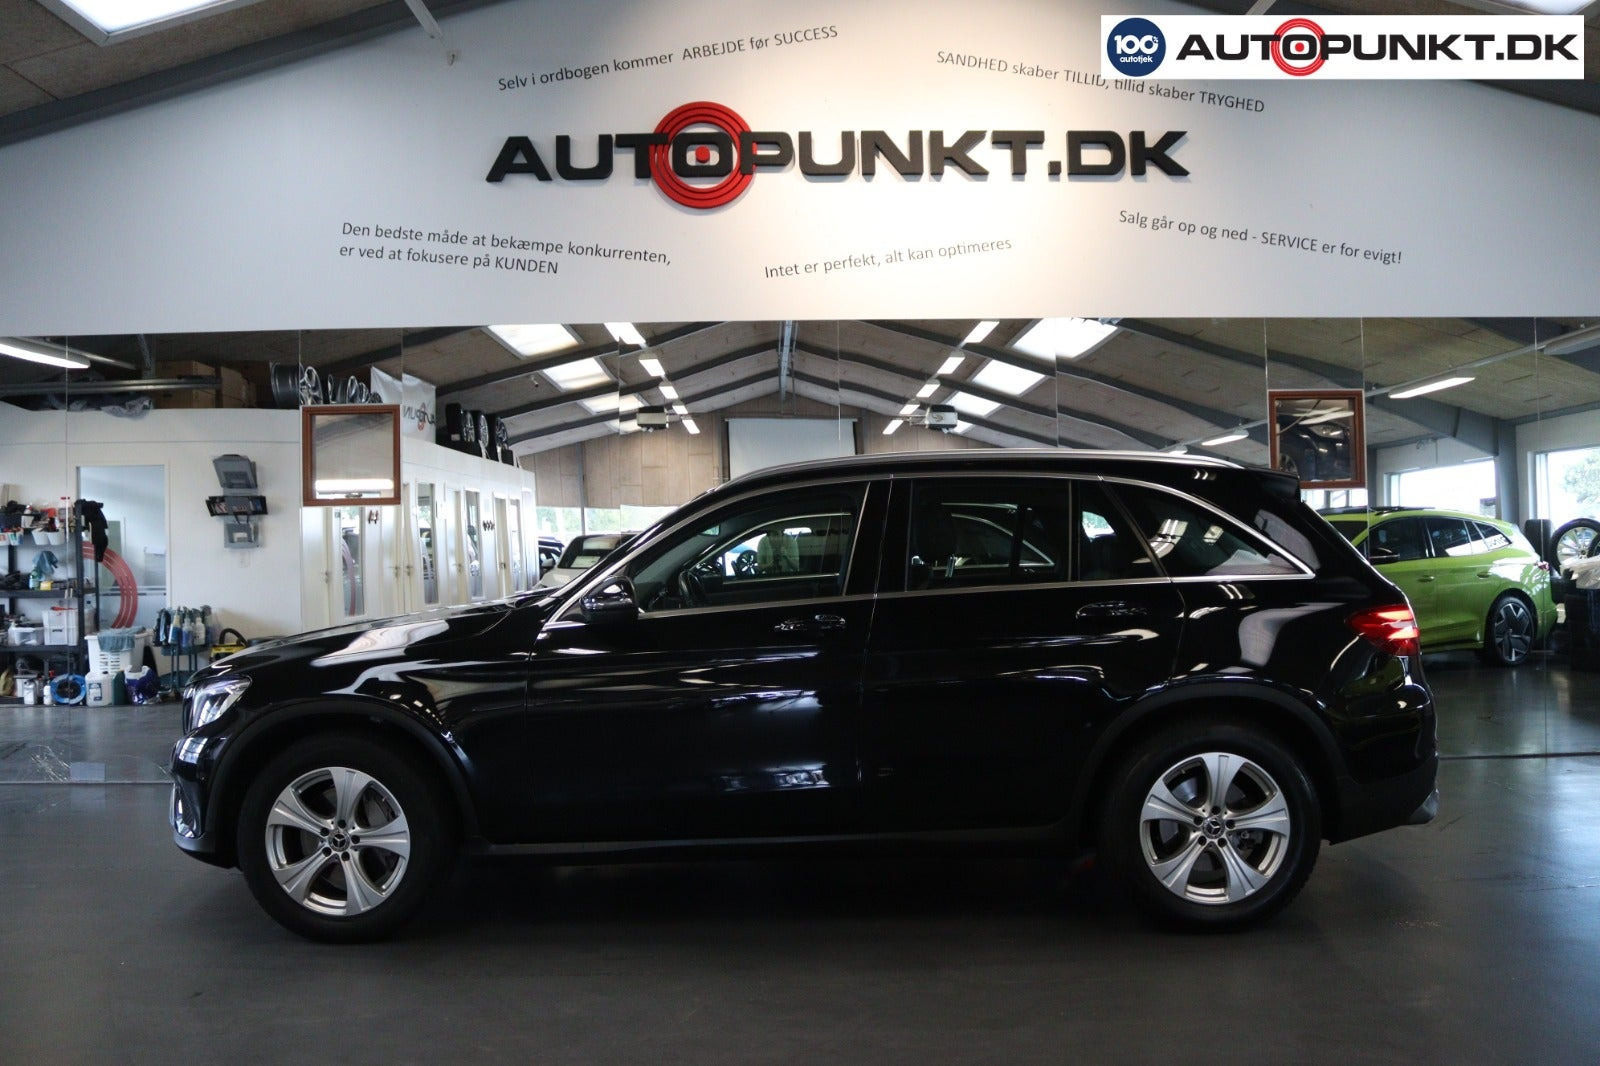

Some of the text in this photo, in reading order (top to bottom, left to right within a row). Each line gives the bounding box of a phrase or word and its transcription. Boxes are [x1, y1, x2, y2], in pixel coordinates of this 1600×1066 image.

[498, 25, 838, 91] Selv i ordbogen kommer ARBEJDE før SUCCESS
[937, 51, 1008, 72] SANDHED
[1013, 63, 1059, 79] skaber
[1149, 84, 1194, 101] skaber
[1200, 91, 1265, 112] TRYGHED
[485, 129, 1190, 184] AUTOPUNKT.DK
[340, 244, 558, 274] er ved at fokusere på KUNDEN
[342, 222, 671, 265] Den bedste måde at bekæmpe konkurrenten,
[764, 238, 1012, 278] Intet er perfekt, alt kan optimeres
[1120, 210, 1148, 228] Salg
[1152, 216, 1174, 230] går
[1178, 222, 1196, 234] op
[1200, 226, 1217, 238] og
[1222, 228, 1248, 240] ned
[1261, 232, 1318, 252] SERVICE
[1322, 242, 1336, 254] er
[1340, 243, 1360, 257] for
[1364, 249, 1402, 265] evigt!
